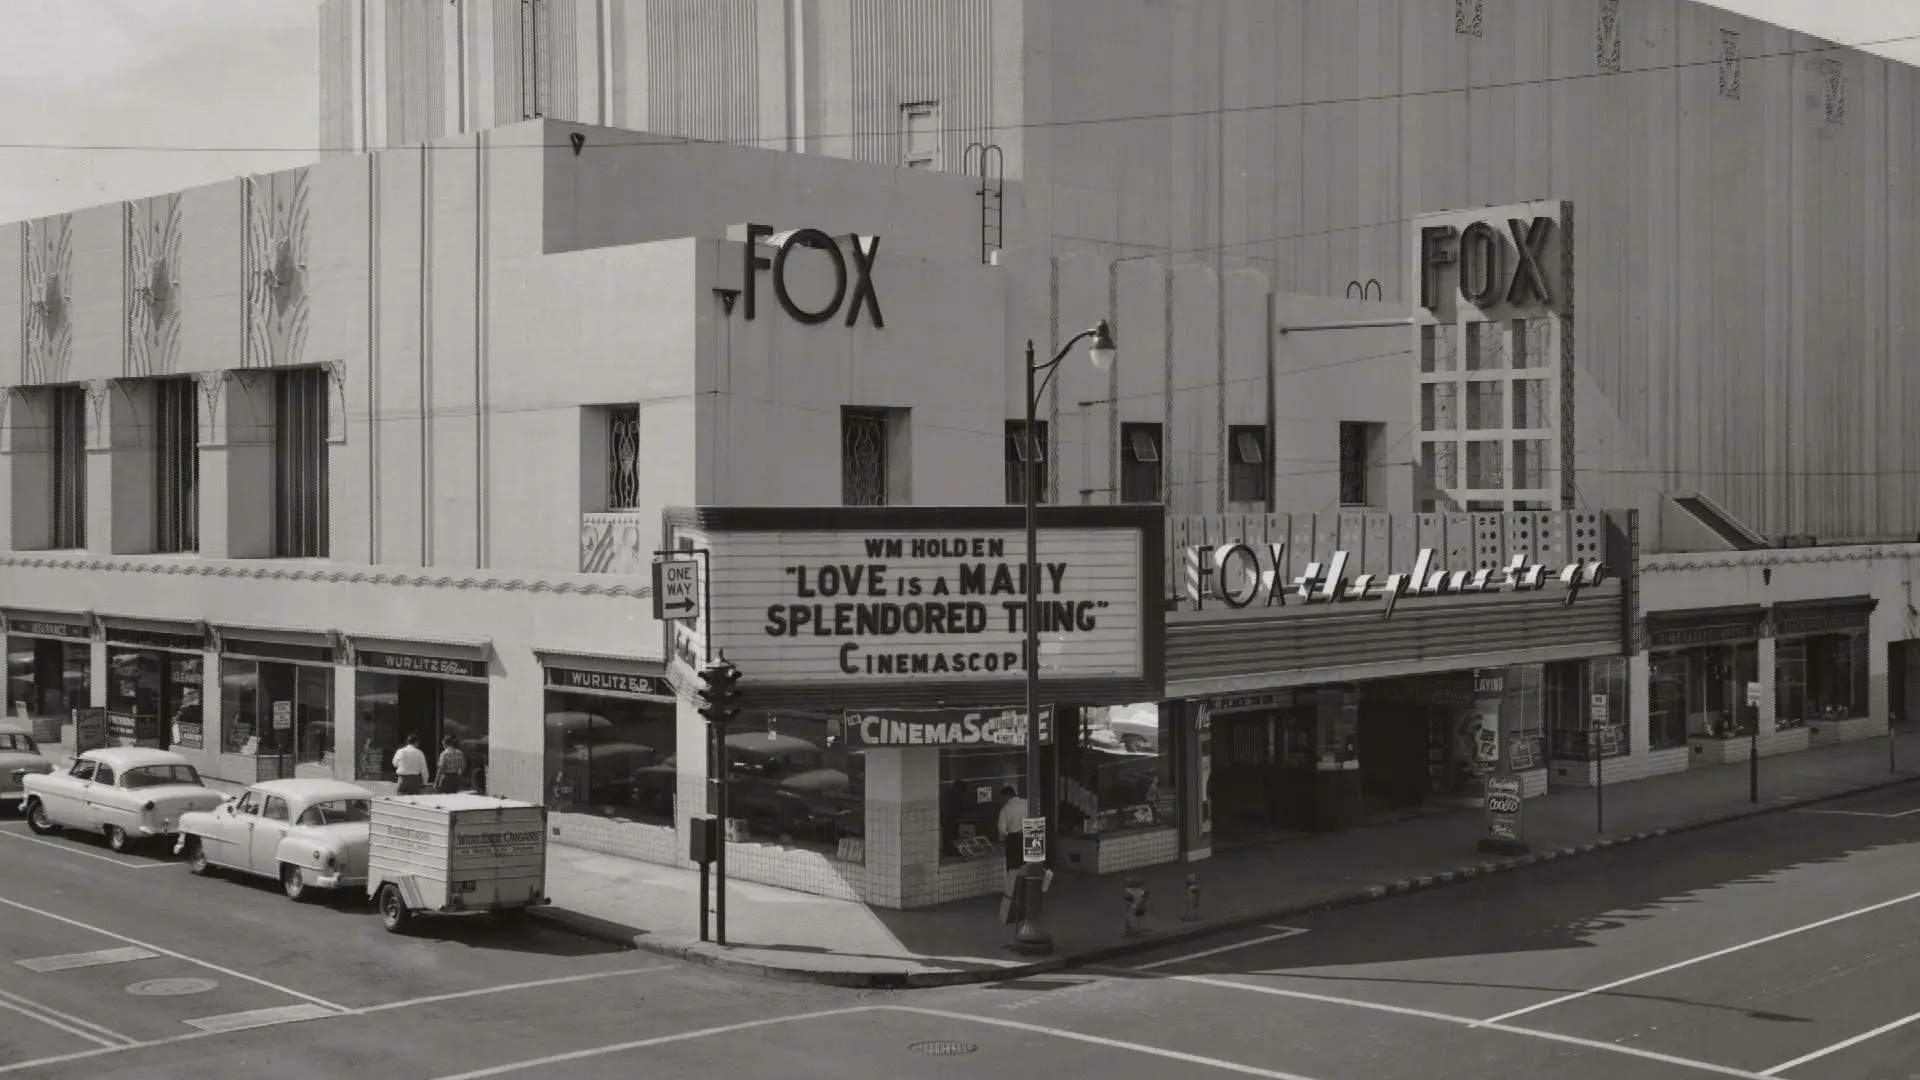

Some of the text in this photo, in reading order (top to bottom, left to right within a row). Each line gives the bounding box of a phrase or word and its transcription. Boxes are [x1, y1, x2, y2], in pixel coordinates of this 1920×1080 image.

[744, 223, 884, 328] FOX
[1421, 216, 1552, 308] FOX
[864, 538, 1004, 558] WM HOLDEN
[667, 567, 692, 581] ONE
[785, 562, 1067, 598] "LOVE IS A MANY
[1187, 543, 1612, 619] FOX the place to go
[667, 583, 692, 596] WAY
[765, 602, 987, 637] SPLENDORED
[385, 654, 458, 674] WURLITZER
[572, 671, 649, 690] WURLITZER
